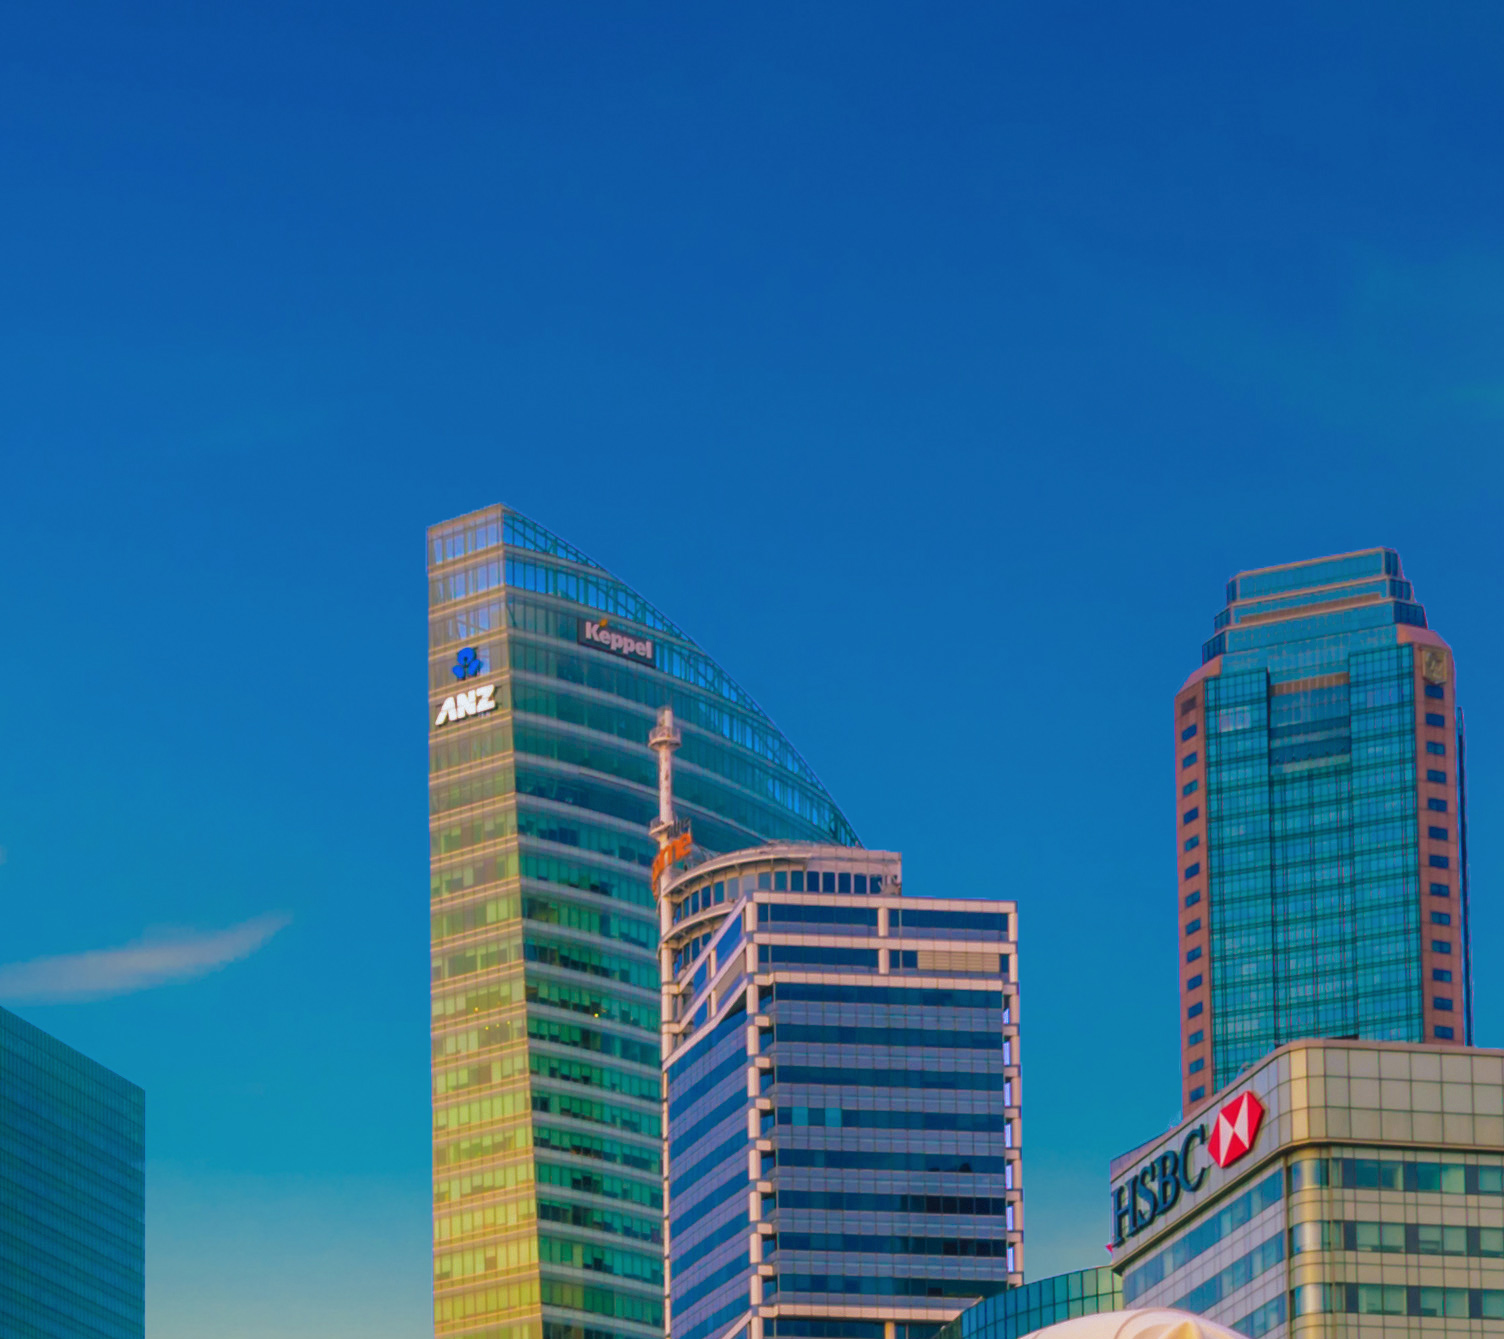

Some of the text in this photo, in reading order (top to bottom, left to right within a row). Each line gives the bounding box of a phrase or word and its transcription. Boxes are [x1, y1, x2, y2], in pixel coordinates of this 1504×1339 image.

[585, 621, 653, 659] Keppel
[435, 684, 496, 726] ANZ
[1111, 1124, 1206, 1248] HSBC
